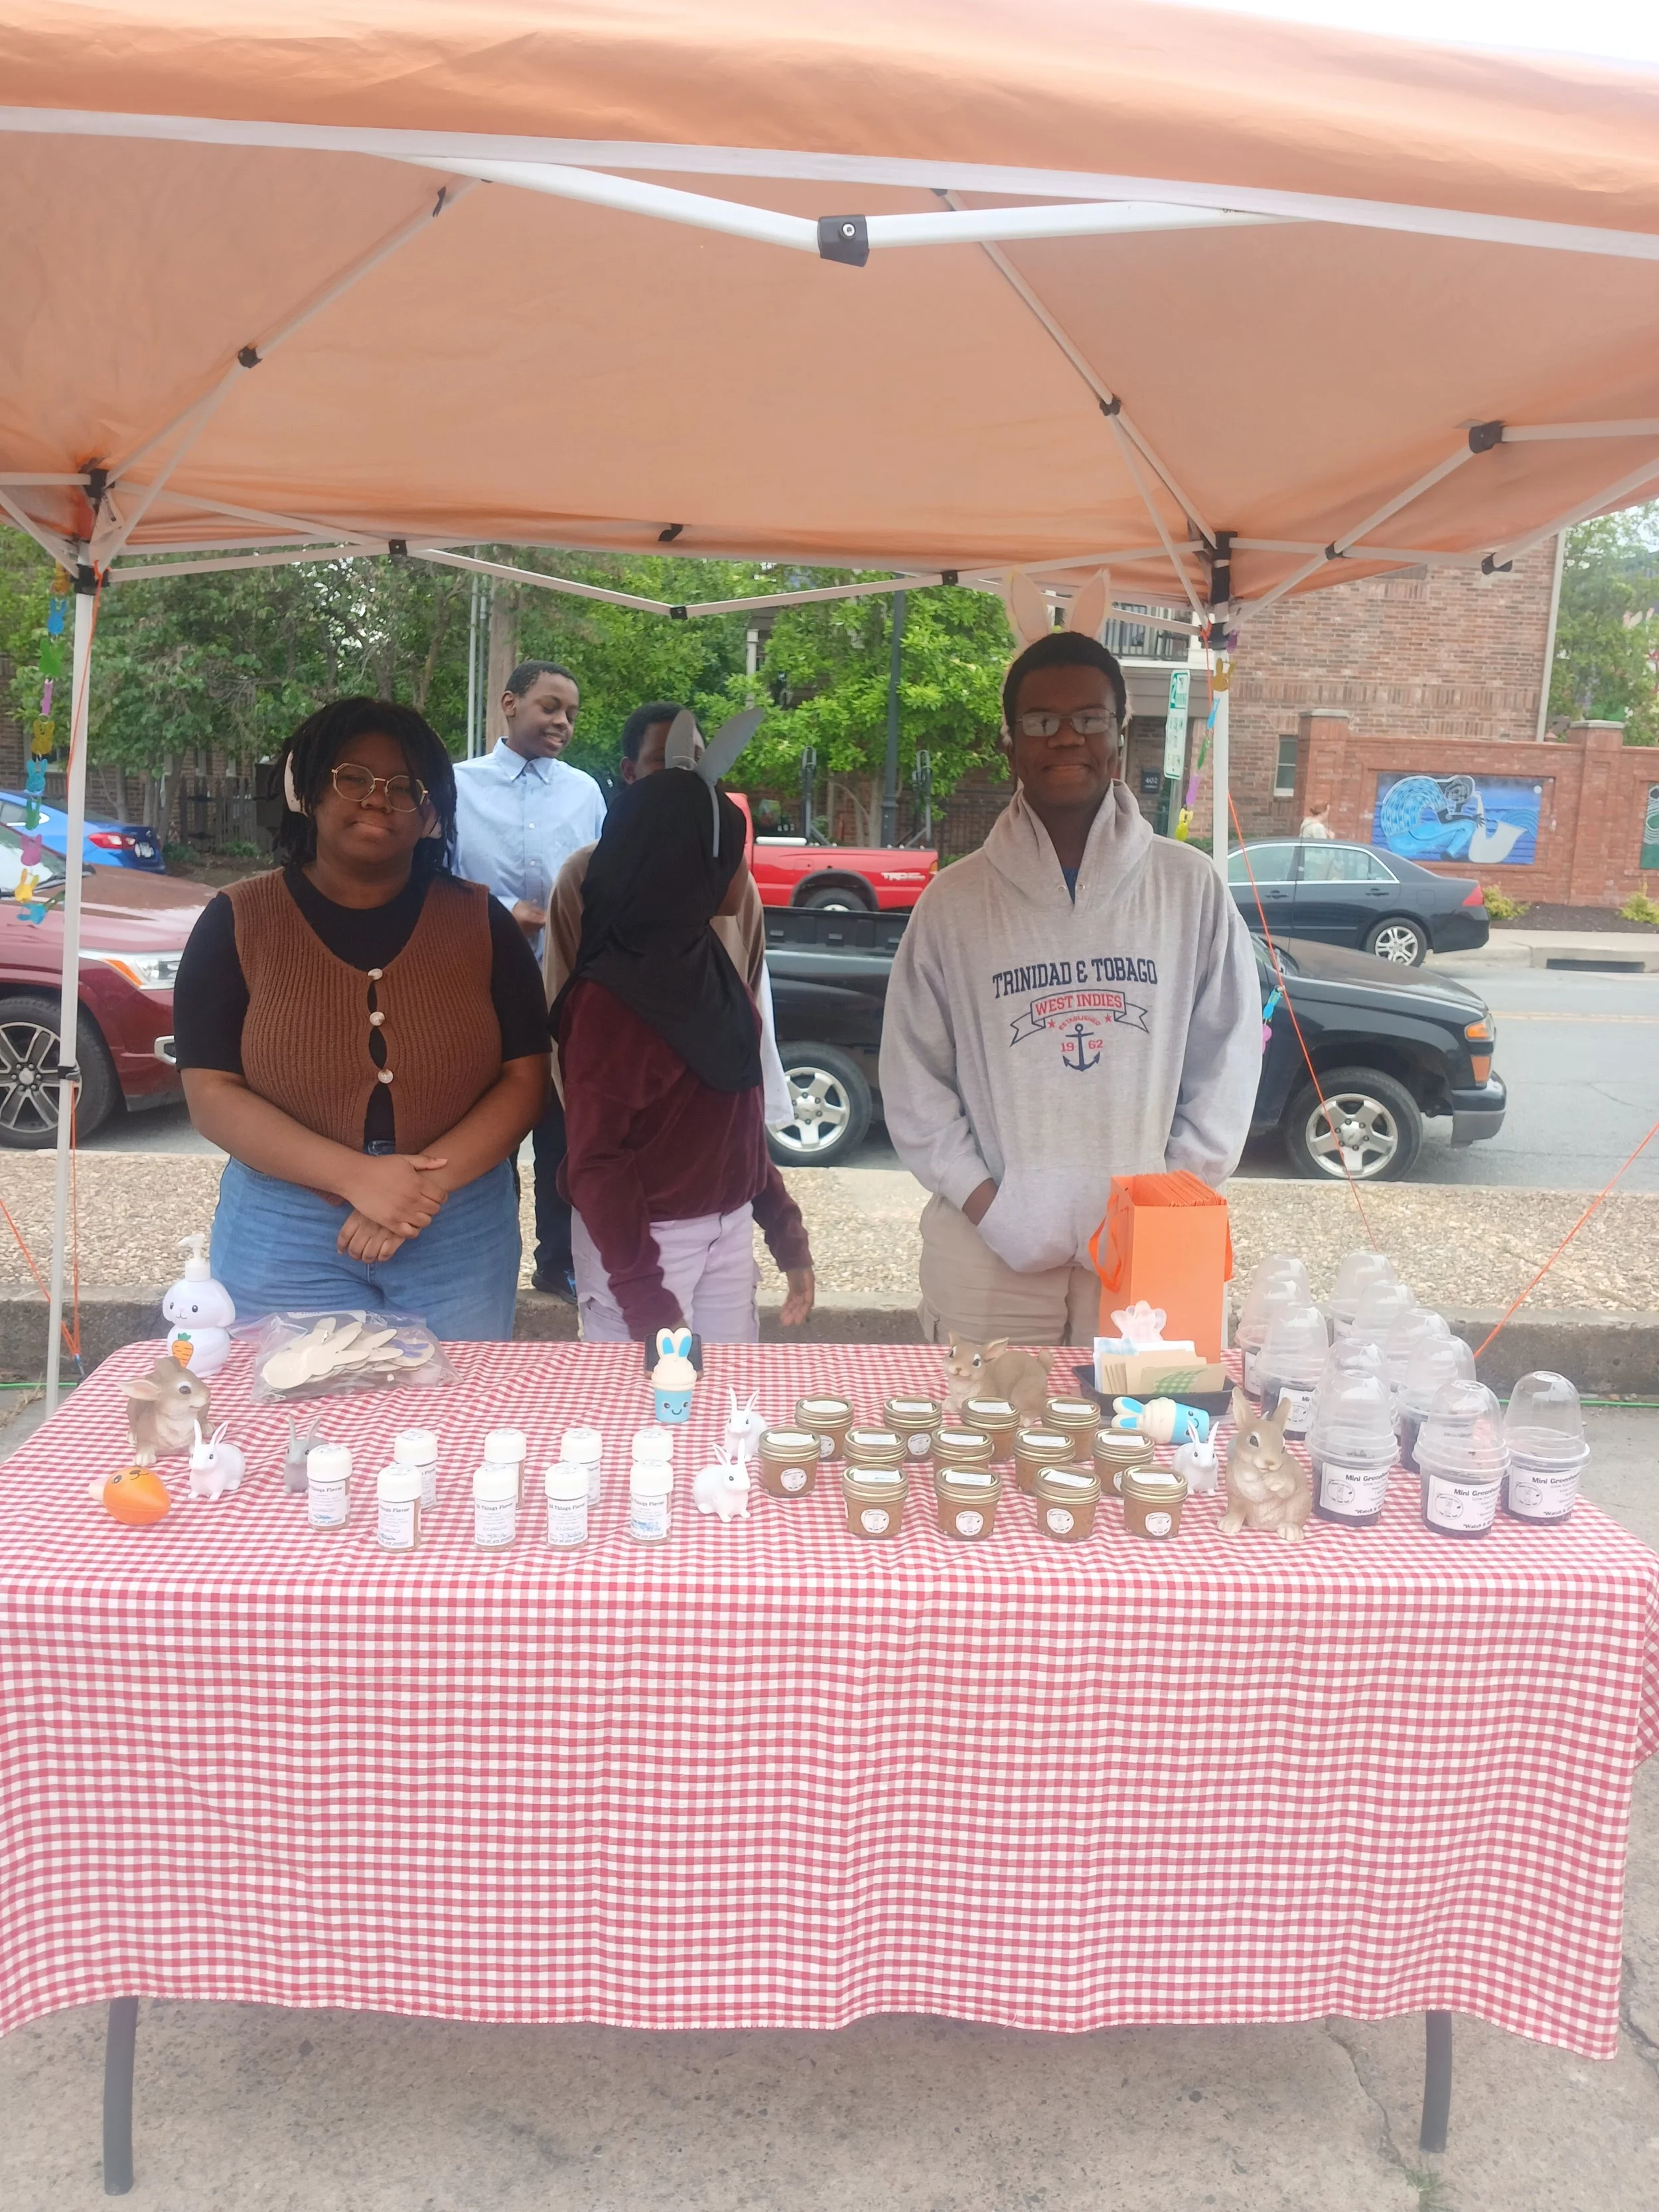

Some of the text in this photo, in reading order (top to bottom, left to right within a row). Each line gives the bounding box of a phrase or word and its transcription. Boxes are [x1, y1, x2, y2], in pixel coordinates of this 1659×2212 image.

[992, 957, 1158, 999] TRINIDAD & TOBAGO
[1035, 993, 1123, 1016] WEST INDIES
[1058, 1015, 1101, 1031] ESTABLISHED
[1061, 1039, 1103, 1052] 19 62
